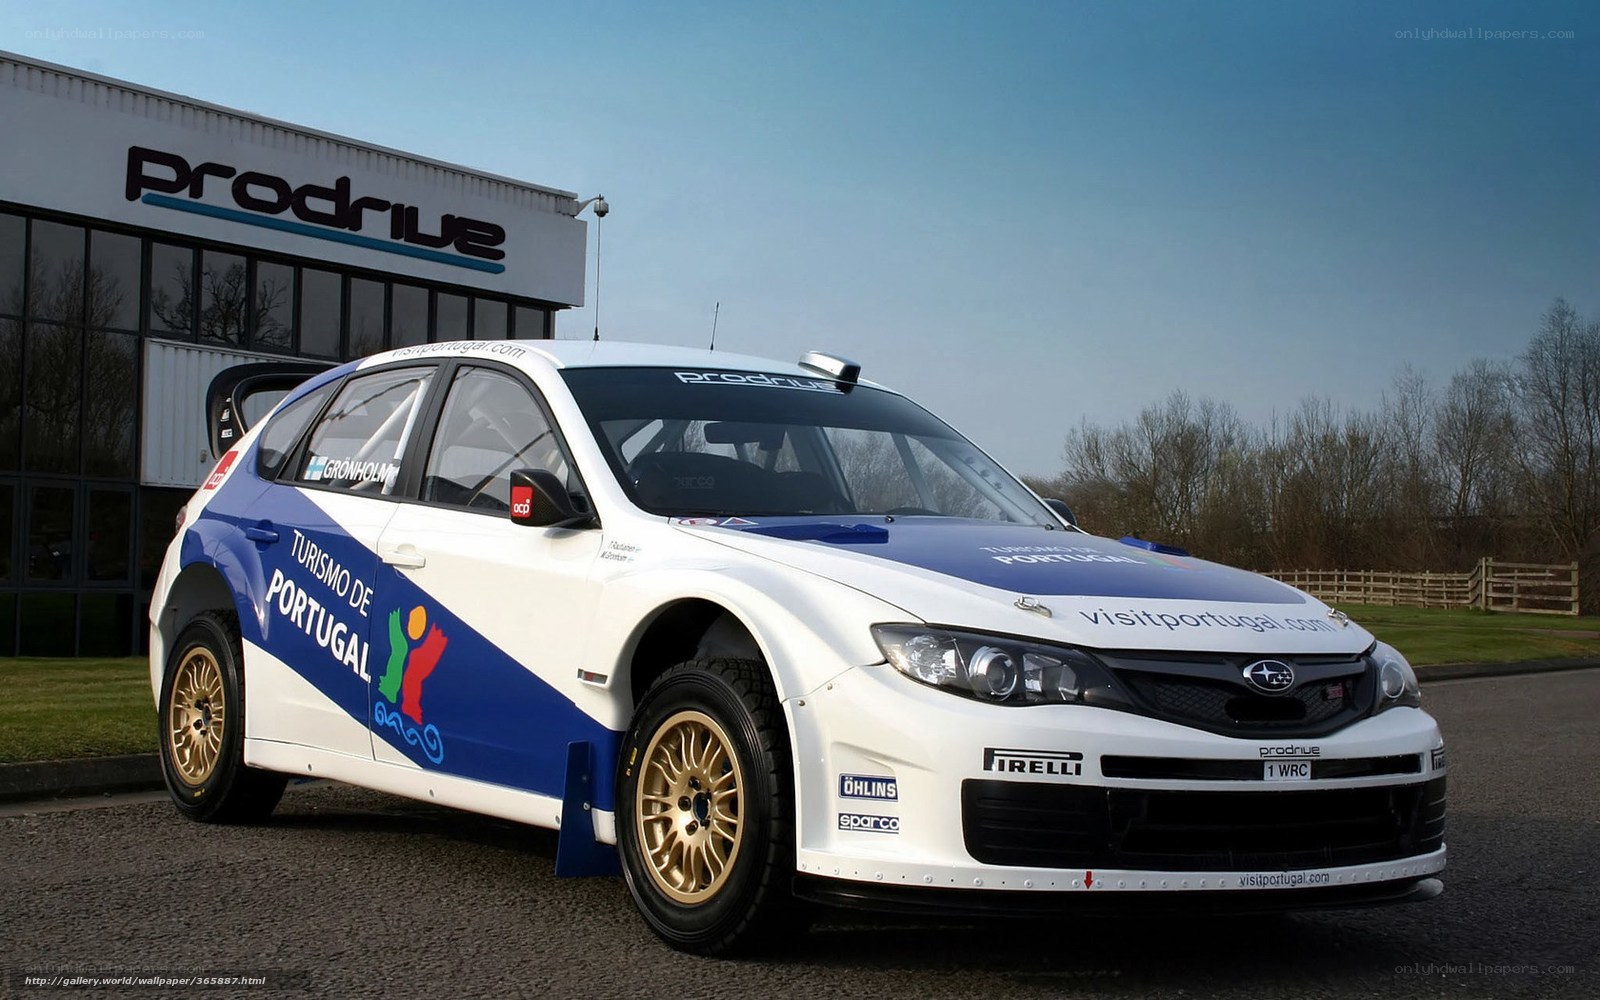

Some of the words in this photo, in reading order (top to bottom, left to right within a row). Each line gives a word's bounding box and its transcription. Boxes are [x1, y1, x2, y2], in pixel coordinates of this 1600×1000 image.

[126, 145, 506, 261] prodrive
[392, 341, 527, 358] visitportugal.com
[674, 371, 844, 392] prodrive
[992, 554, 1148, 565] PORTUGAL
[291, 529, 350, 597] TURISMO
[349, 578, 373, 617] DE
[265, 568, 372, 684] PORTUGAL
[1079, 608, 1338, 633] visitportugal.com
[983, 747, 1084, 776] PIRELLI
[1259, 744, 1320, 758] prodrive
[1268, 765, 1274, 777] 1
[1278, 763, 1308, 777] WRC
[844, 776, 897, 798] ÖHLINS
[840, 814, 899, 832] sparco
[1240, 872, 1330, 888] visitportugal.com
